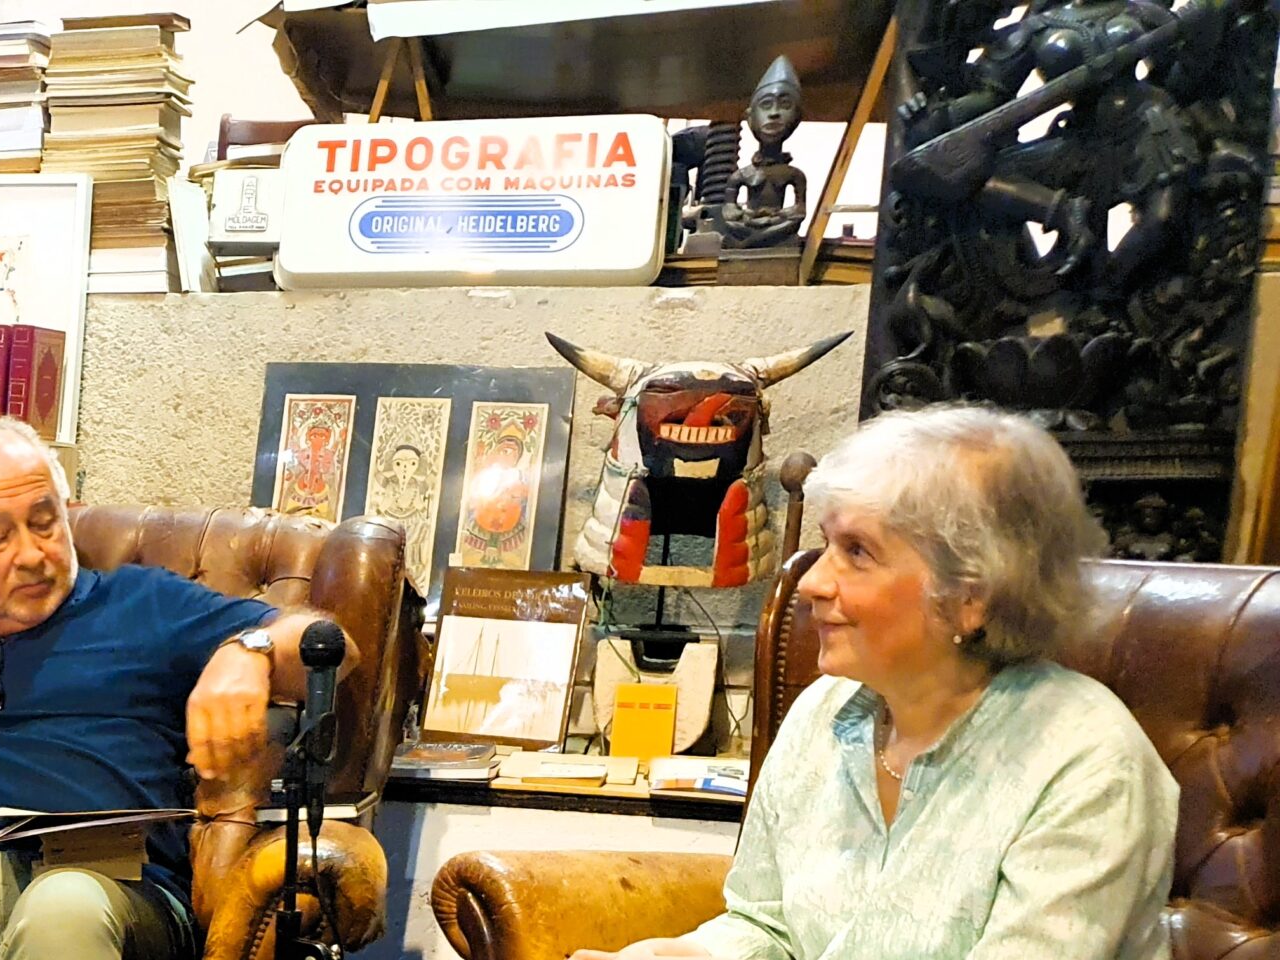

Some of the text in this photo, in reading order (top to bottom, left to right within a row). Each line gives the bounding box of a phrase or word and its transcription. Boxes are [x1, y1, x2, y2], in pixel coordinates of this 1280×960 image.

[317, 131, 637, 173] TIPOGRAFIA
[242, 180, 256, 214] ARTE
[313, 173, 637, 195] EQUIPADA COM MAQUINAS
[371, 215, 561, 234] ORIGINAL HEIDELBERG
